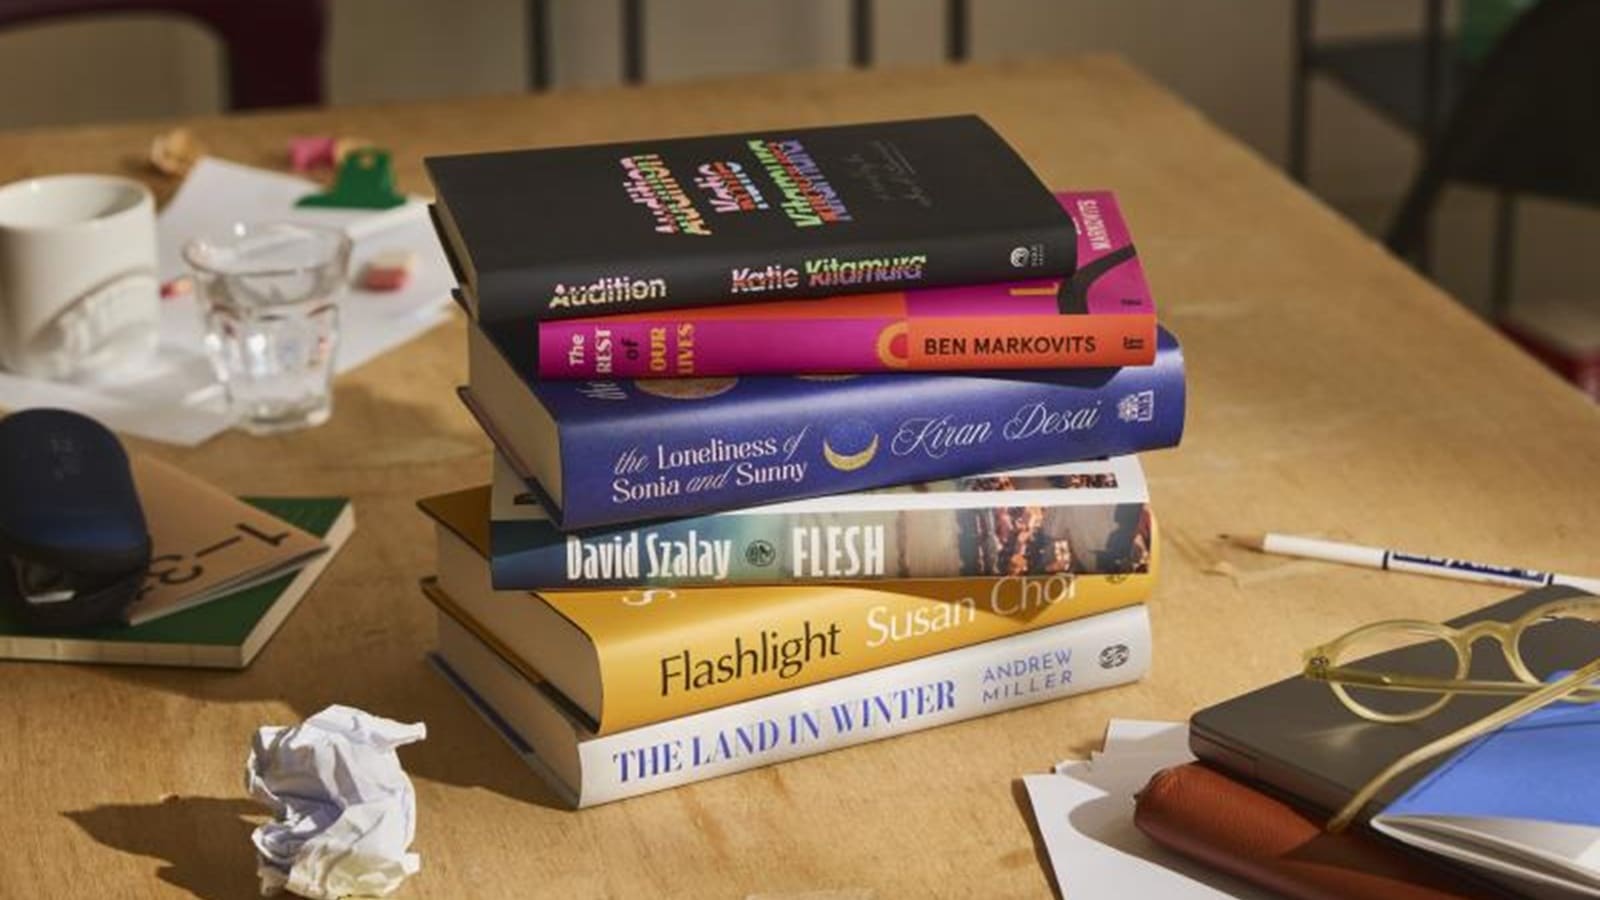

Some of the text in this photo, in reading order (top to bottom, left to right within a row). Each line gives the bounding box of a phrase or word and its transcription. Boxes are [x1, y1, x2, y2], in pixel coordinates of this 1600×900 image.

[1077, 199, 1112, 250] MARKOVITS
[549, 276, 666, 309] Audition
[731, 254, 927, 293] Katie Kitamura
[569, 333, 585, 366] The
[595, 328, 612, 373] REST
[621, 338, 638, 360] of
[650, 327, 667, 372] OUR
[677, 322, 695, 374] LIVES
[924, 336, 1097, 355] BEN MARKOVITS
[614, 424, 811, 476] the Loneliness of
[891, 399, 1103, 458] Kiran Desai
[612, 460, 809, 503] Sonia and Sunny
[566, 529, 733, 581] David Szalay
[792, 525, 885, 577] FLESH
[866, 596, 977, 648] Susan
[660, 620, 841, 697] Flashlight
[982, 648, 1073, 684] ANDREW
[982, 670, 1073, 704] MILLER
[612, 679, 956, 783] THE LAND IN WINTER
